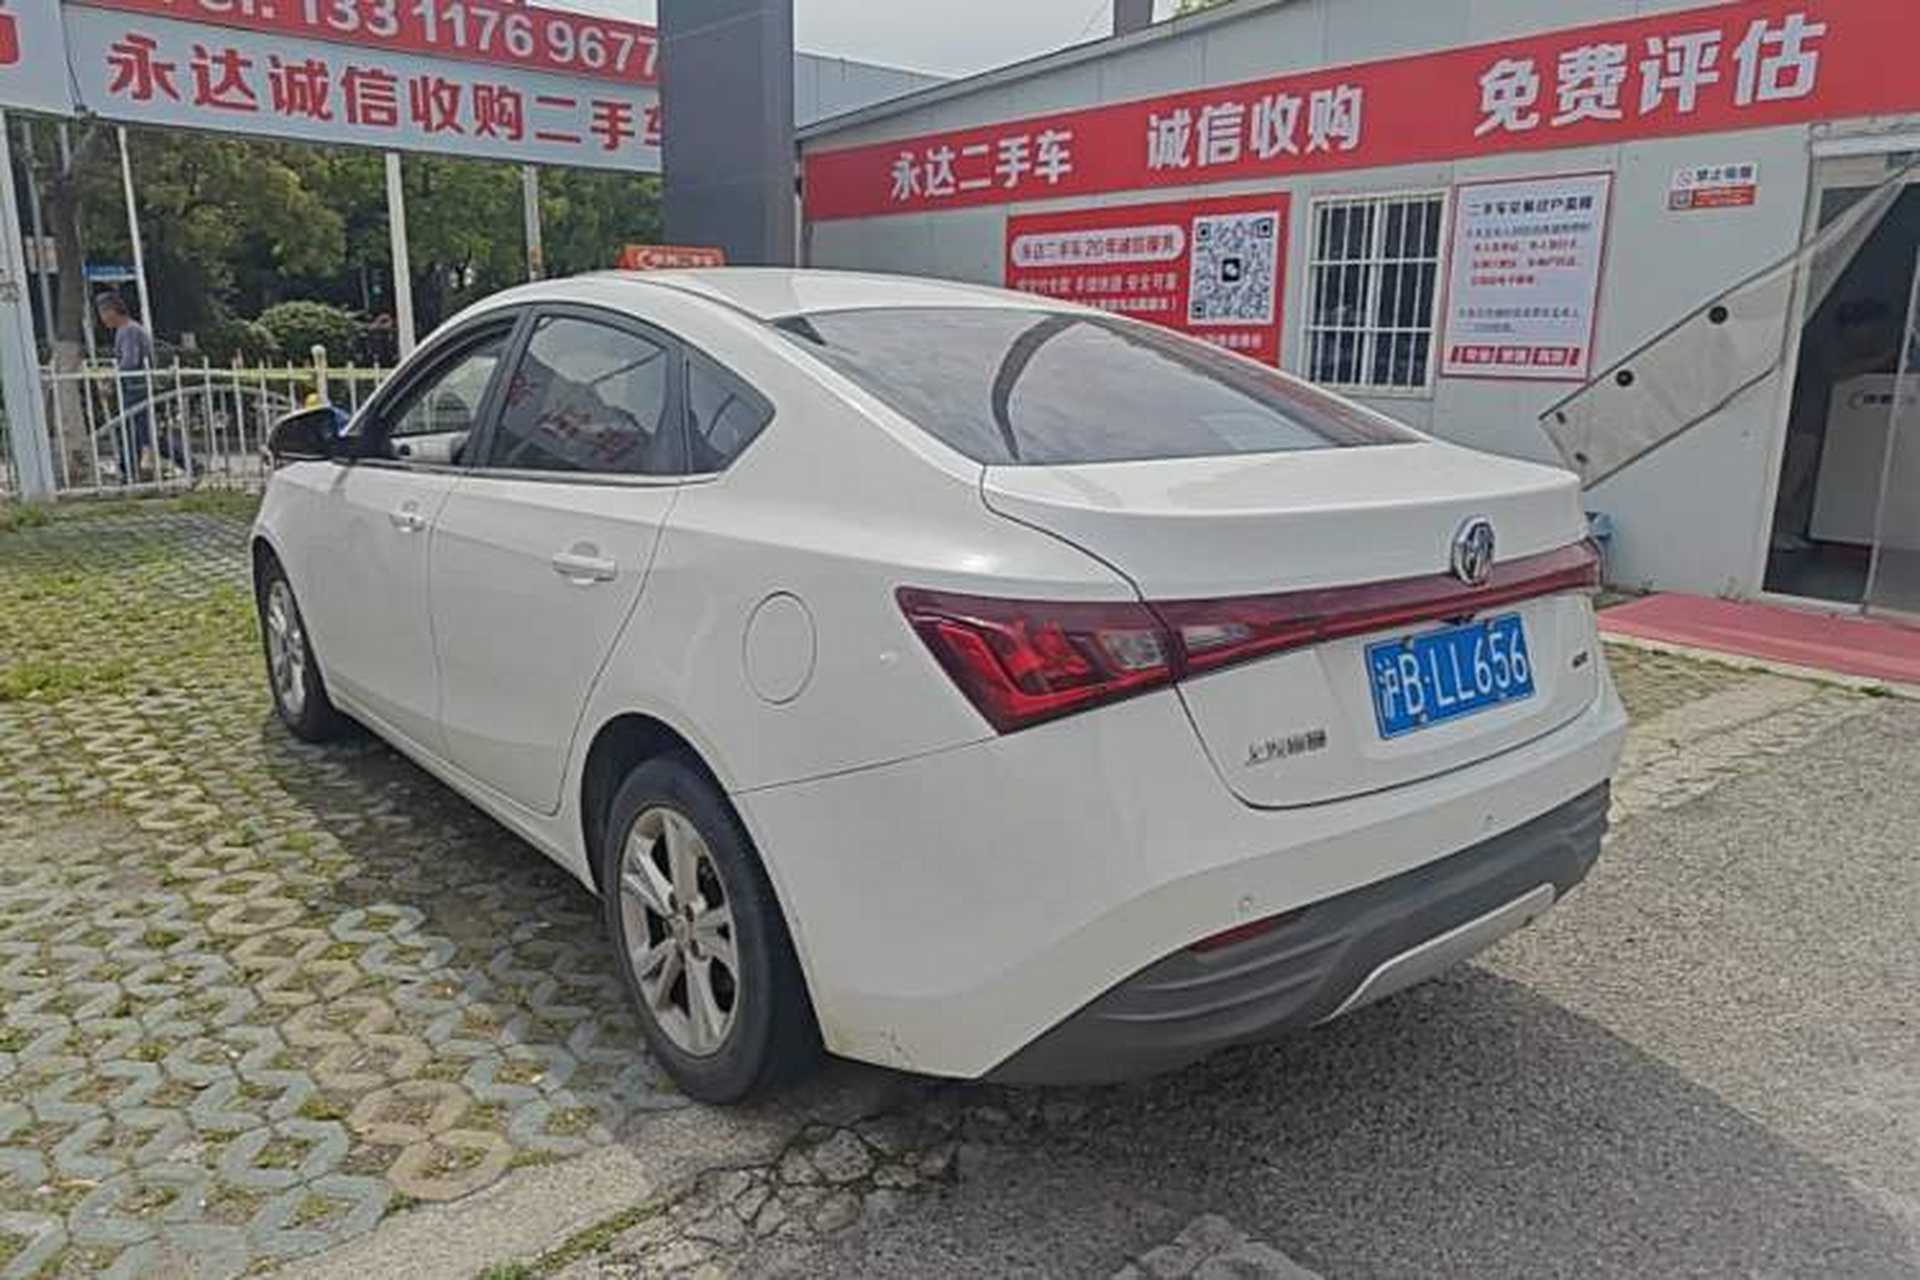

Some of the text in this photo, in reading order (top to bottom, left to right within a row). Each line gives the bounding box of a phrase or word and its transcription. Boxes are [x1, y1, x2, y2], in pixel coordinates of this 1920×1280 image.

[412, 5, 533, 57] 1176
[546, 20, 658, 77] 9677
[1473, 13, 1827, 137] 免费评估
[890, 130, 1073, 201] 永达二手车
[1147, 83, 1364, 171] 诚信收购
